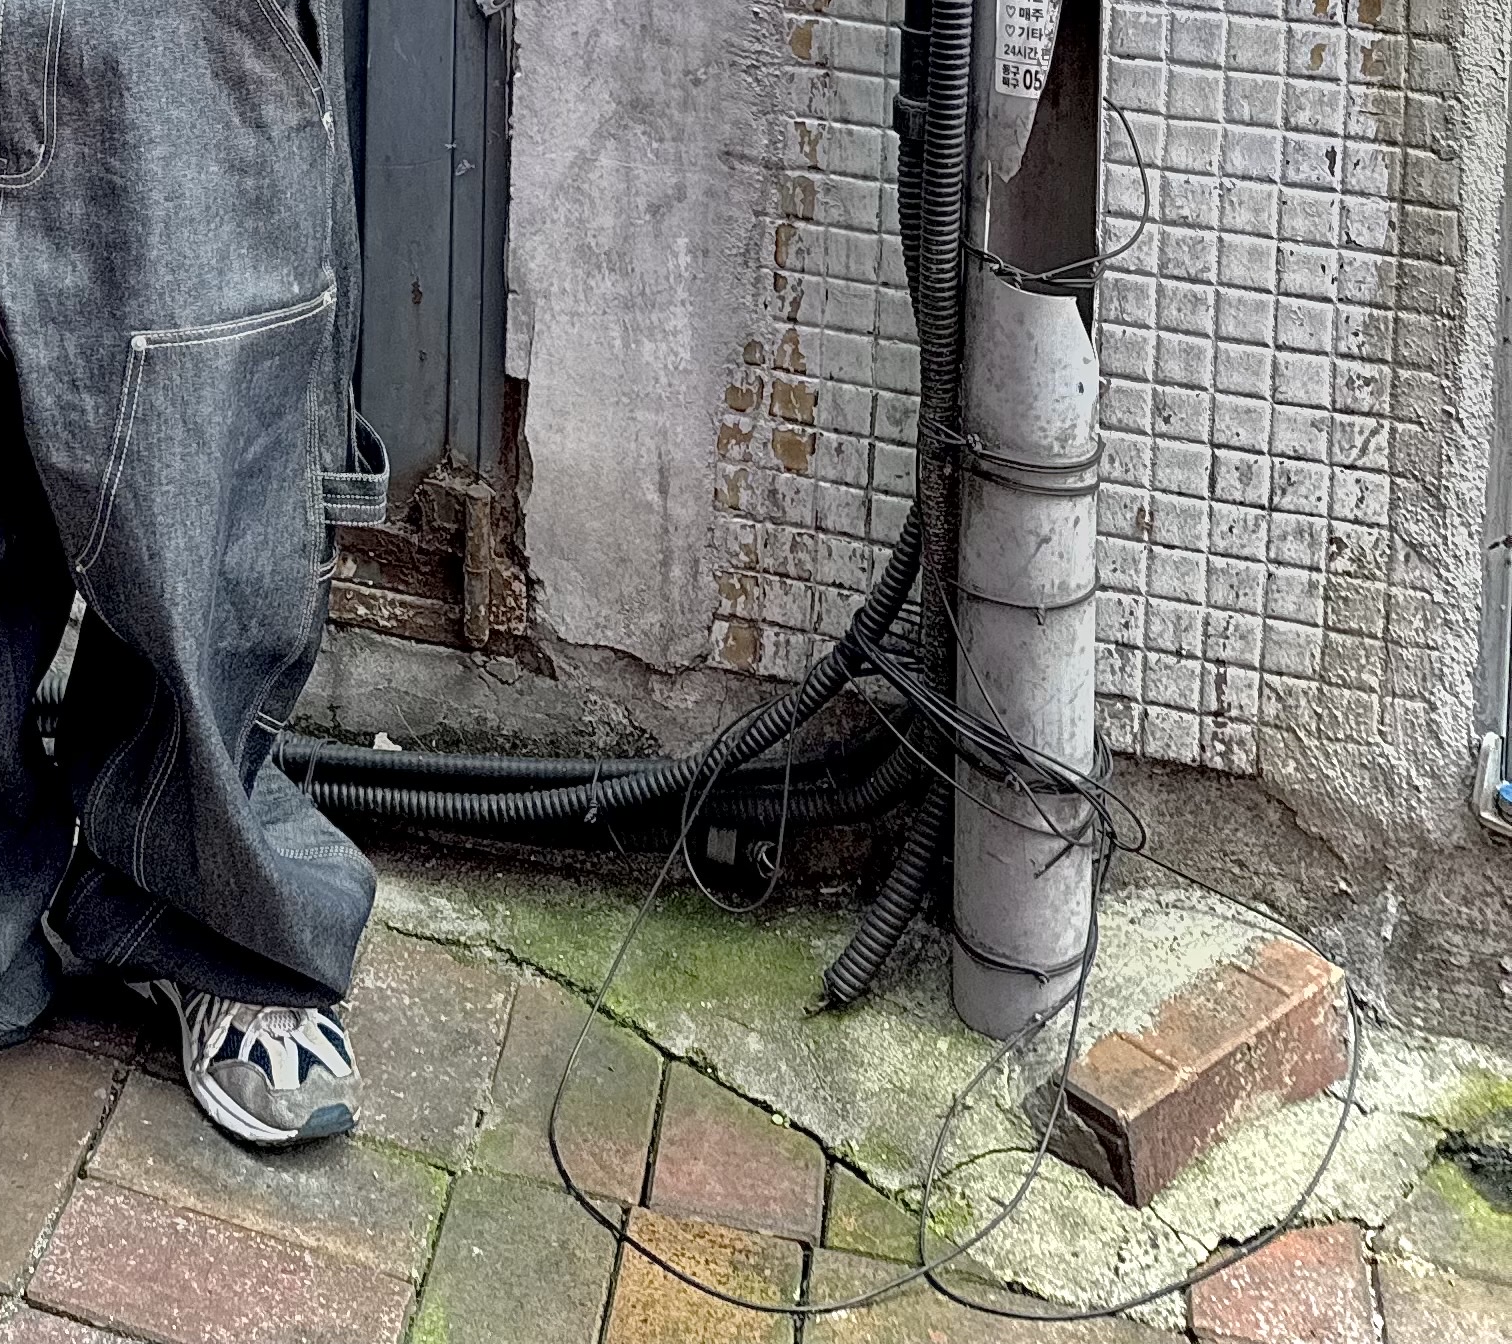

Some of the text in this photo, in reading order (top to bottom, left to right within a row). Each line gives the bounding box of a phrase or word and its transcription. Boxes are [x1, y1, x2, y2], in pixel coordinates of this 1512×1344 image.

[1019, 7, 1044, 22] 매주
[1018, 26, 1043, 41] 기타
[1004, 43, 1038, 60] 24시간
